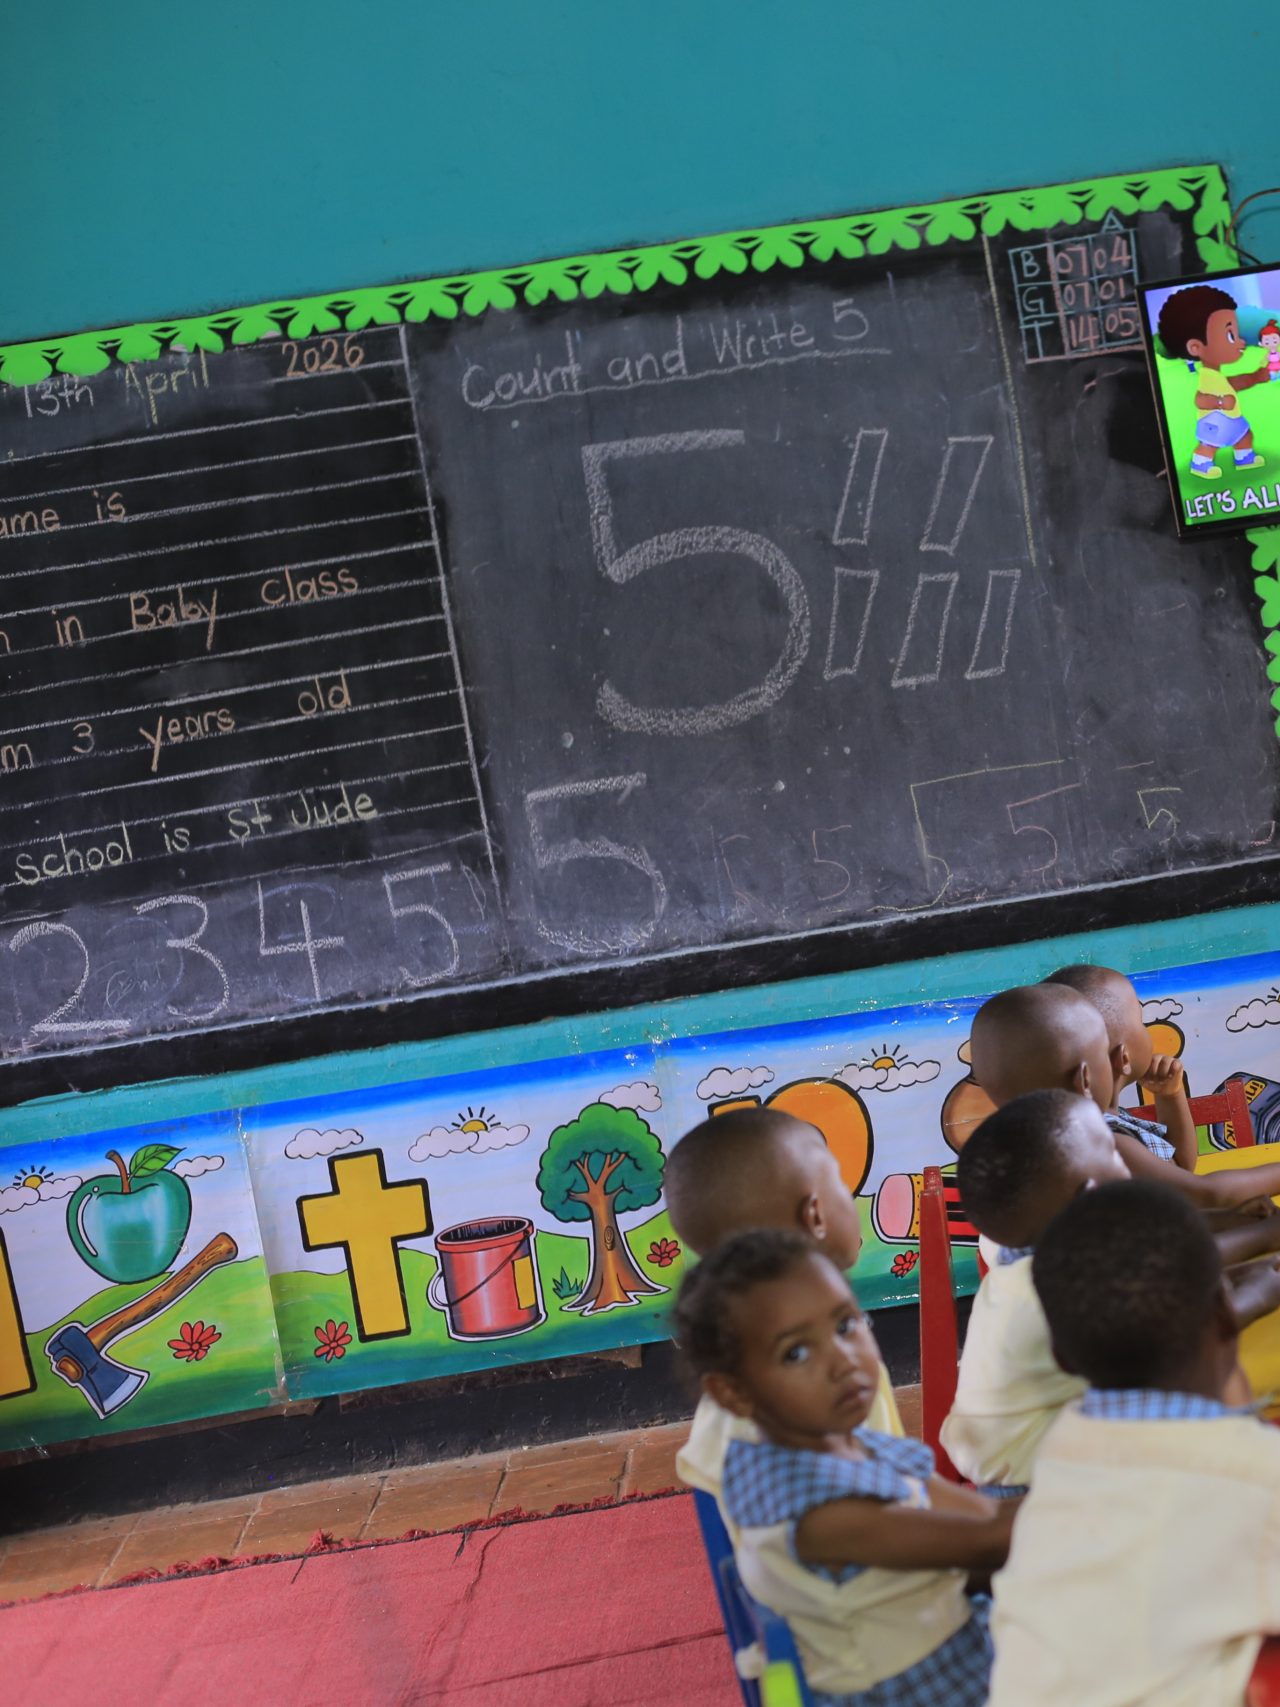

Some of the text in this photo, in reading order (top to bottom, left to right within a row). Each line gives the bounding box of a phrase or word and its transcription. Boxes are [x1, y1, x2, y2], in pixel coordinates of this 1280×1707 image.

[1020, 236, 1132, 278] B 07 04
[1022, 277, 1126, 316] G 07 01
[1070, 315, 1100, 350] 14
[1105, 306, 1138, 337] 05
[607, 314, 689, 386] and
[709, 312, 816, 366] Write
[831, 298, 870, 342] 5
[23, 333, 365, 426] 13th April 2026
[93, 489, 126, 524] is
[1185, 489, 1237, 519] LET'S
[51, 609, 86, 648] in
[129, 584, 218, 651] Baby
[582, 428, 811, 736] 5
[72, 722, 96, 754] 3
[139, 708, 236, 773] years
[297, 667, 352, 717] old
[162, 820, 191, 855] is
[290, 780, 379, 829] Jude
[8, 862, 460, 1034] 2 3 4 5
